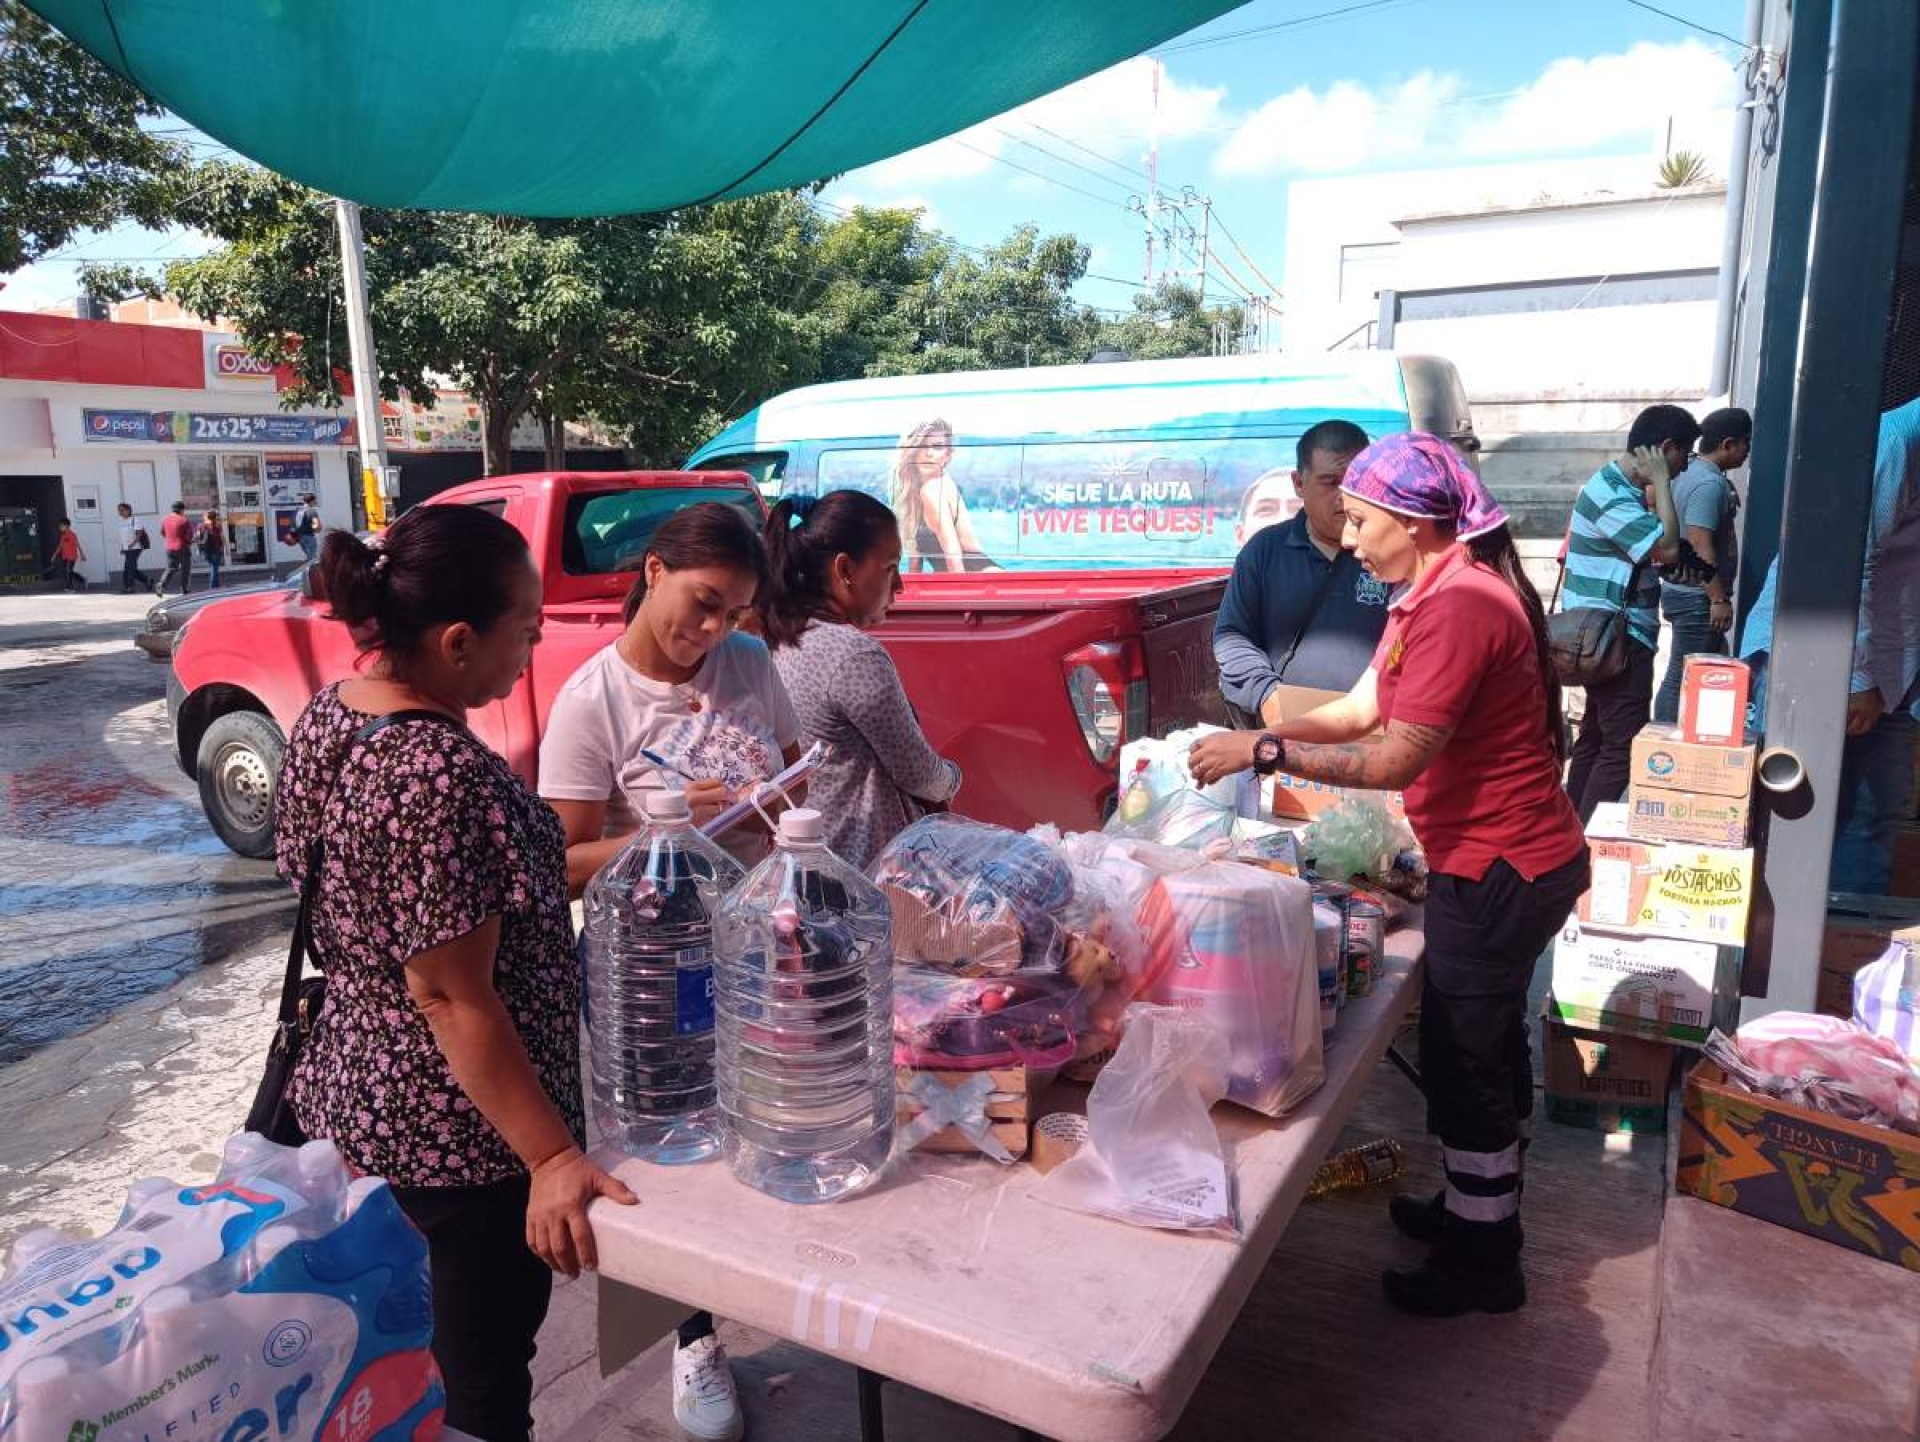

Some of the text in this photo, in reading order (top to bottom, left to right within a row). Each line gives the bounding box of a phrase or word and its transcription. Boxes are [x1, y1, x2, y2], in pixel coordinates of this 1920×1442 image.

[221, 353, 273, 373] OXXO
[112, 419, 145, 433] pepsi
[1042, 481, 1193, 503] SIGUE LA RUTA
[1021, 507, 1217, 536] ¡VIVE TEQUES!
[101, 1377, 176, 1428] Member's
[336, 1386, 372, 1437] 18
